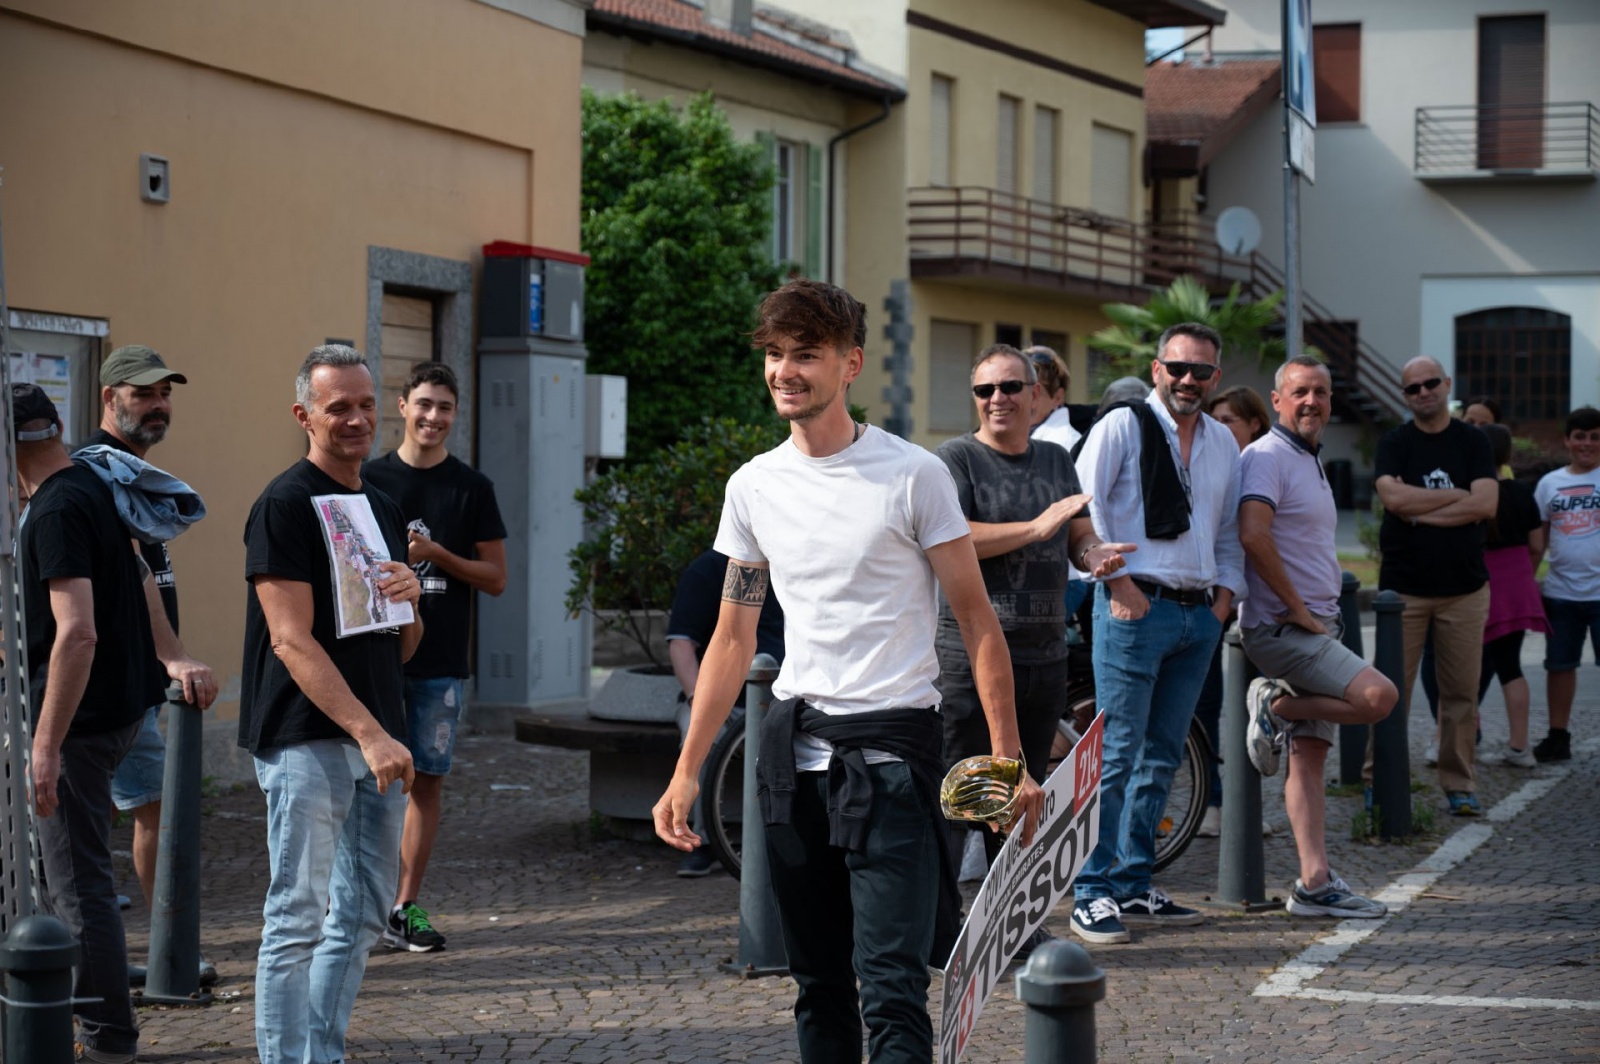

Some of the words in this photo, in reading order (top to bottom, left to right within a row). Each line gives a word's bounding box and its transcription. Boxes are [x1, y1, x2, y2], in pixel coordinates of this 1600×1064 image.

[1077, 732, 1099, 801] 214
[1003, 789, 1056, 881] Alesdro
[1012, 843, 1043, 888] EMIRATES
[978, 791, 1098, 1002] TISSOT
